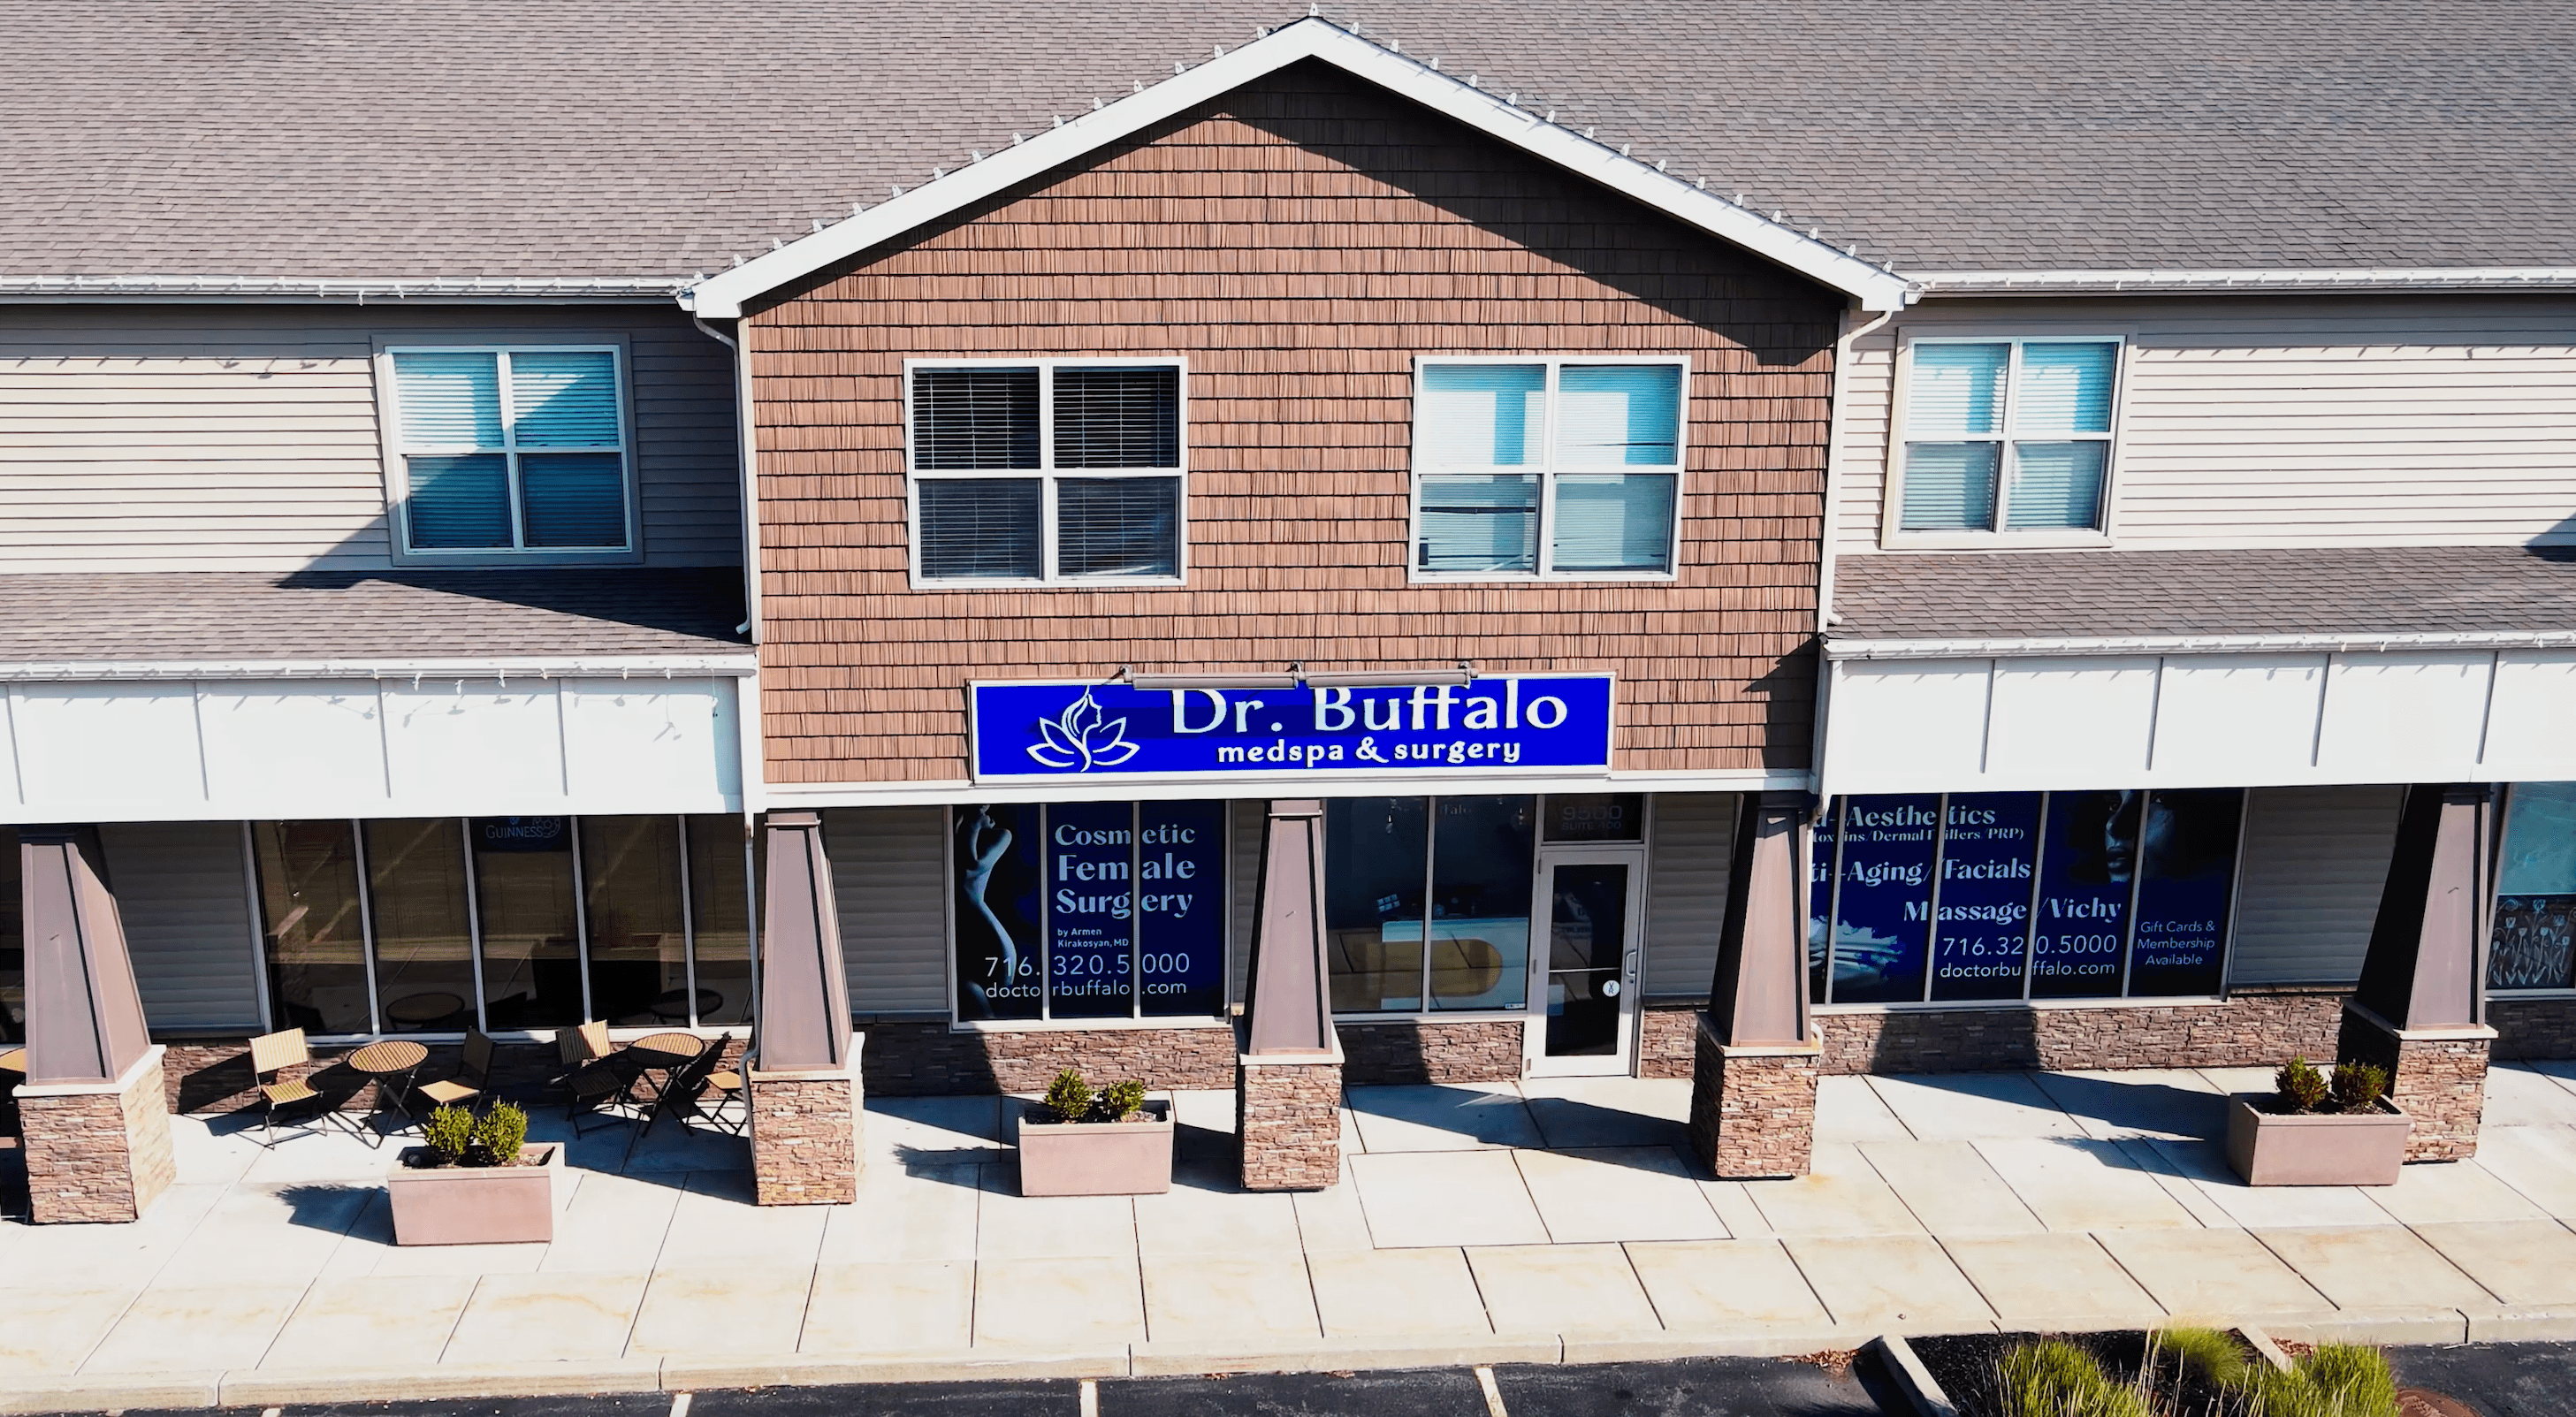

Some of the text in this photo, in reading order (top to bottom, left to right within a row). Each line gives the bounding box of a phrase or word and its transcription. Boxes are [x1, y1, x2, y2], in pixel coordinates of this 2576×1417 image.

[1172, 679, 1568, 733] Dr. Buffalo
[1218, 736, 1520, 767] medspa & surgery
[485, 825, 544, 839] GUINNESS
[1055, 824, 1196, 846] Cosmetic
[1561, 821, 1595, 831] SUITE
[1058, 852, 1196, 881] Female
[1056, 888, 1193, 919] Surgery
[1057, 928, 1068, 937] by
[2140, 920, 2215, 933] Gift Cards &
[1113, 938, 1129, 947] MD
[1942, 934, 2117, 956] 716.320.5000
[2137, 937, 2215, 950] Membership
[985, 953, 1190, 977] 716.320.5000
[2145, 954, 2203, 965] Available
[1940, 960, 2115, 978] doctorbuffalo.com
[985, 979, 1187, 998] doctorbuffalo.com
